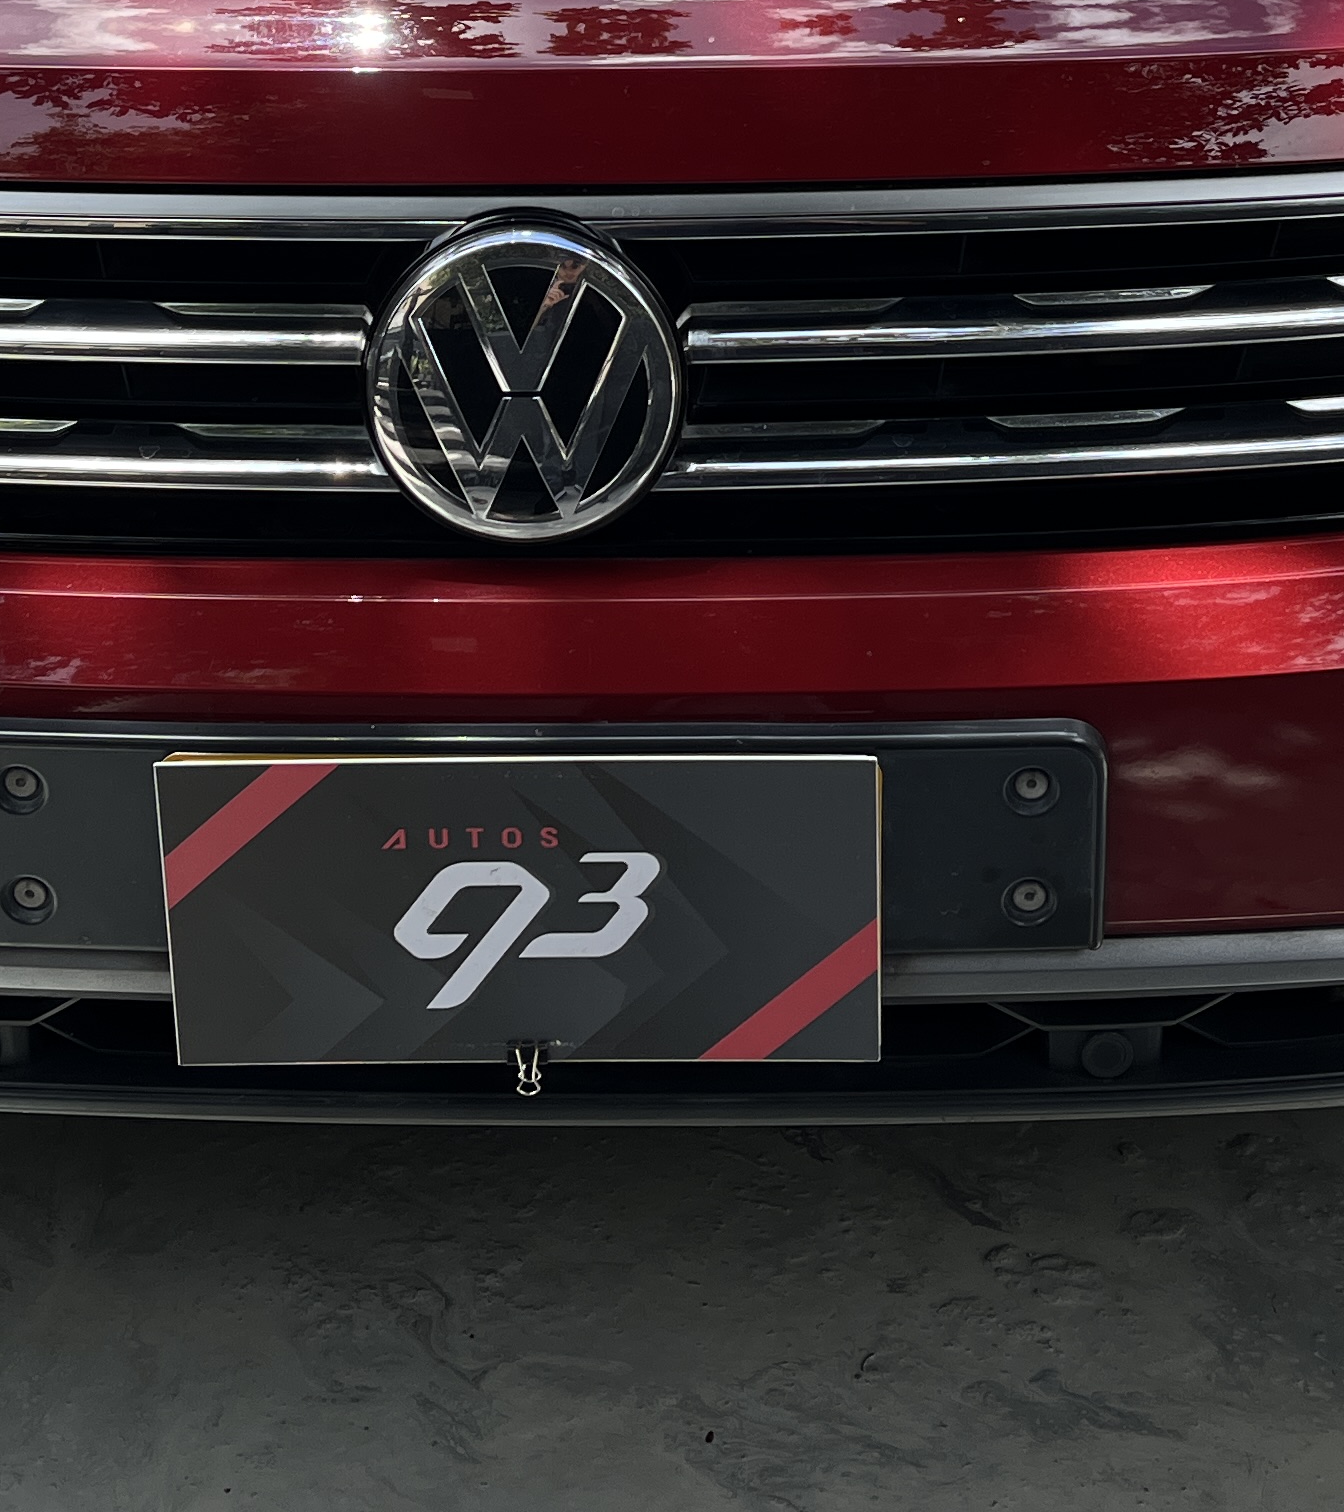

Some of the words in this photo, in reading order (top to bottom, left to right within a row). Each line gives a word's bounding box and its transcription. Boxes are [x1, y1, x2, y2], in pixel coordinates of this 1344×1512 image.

[384, 258, 651, 521] VW
[381, 826, 560, 850] AUTOS
[393, 851, 661, 1010] 93
